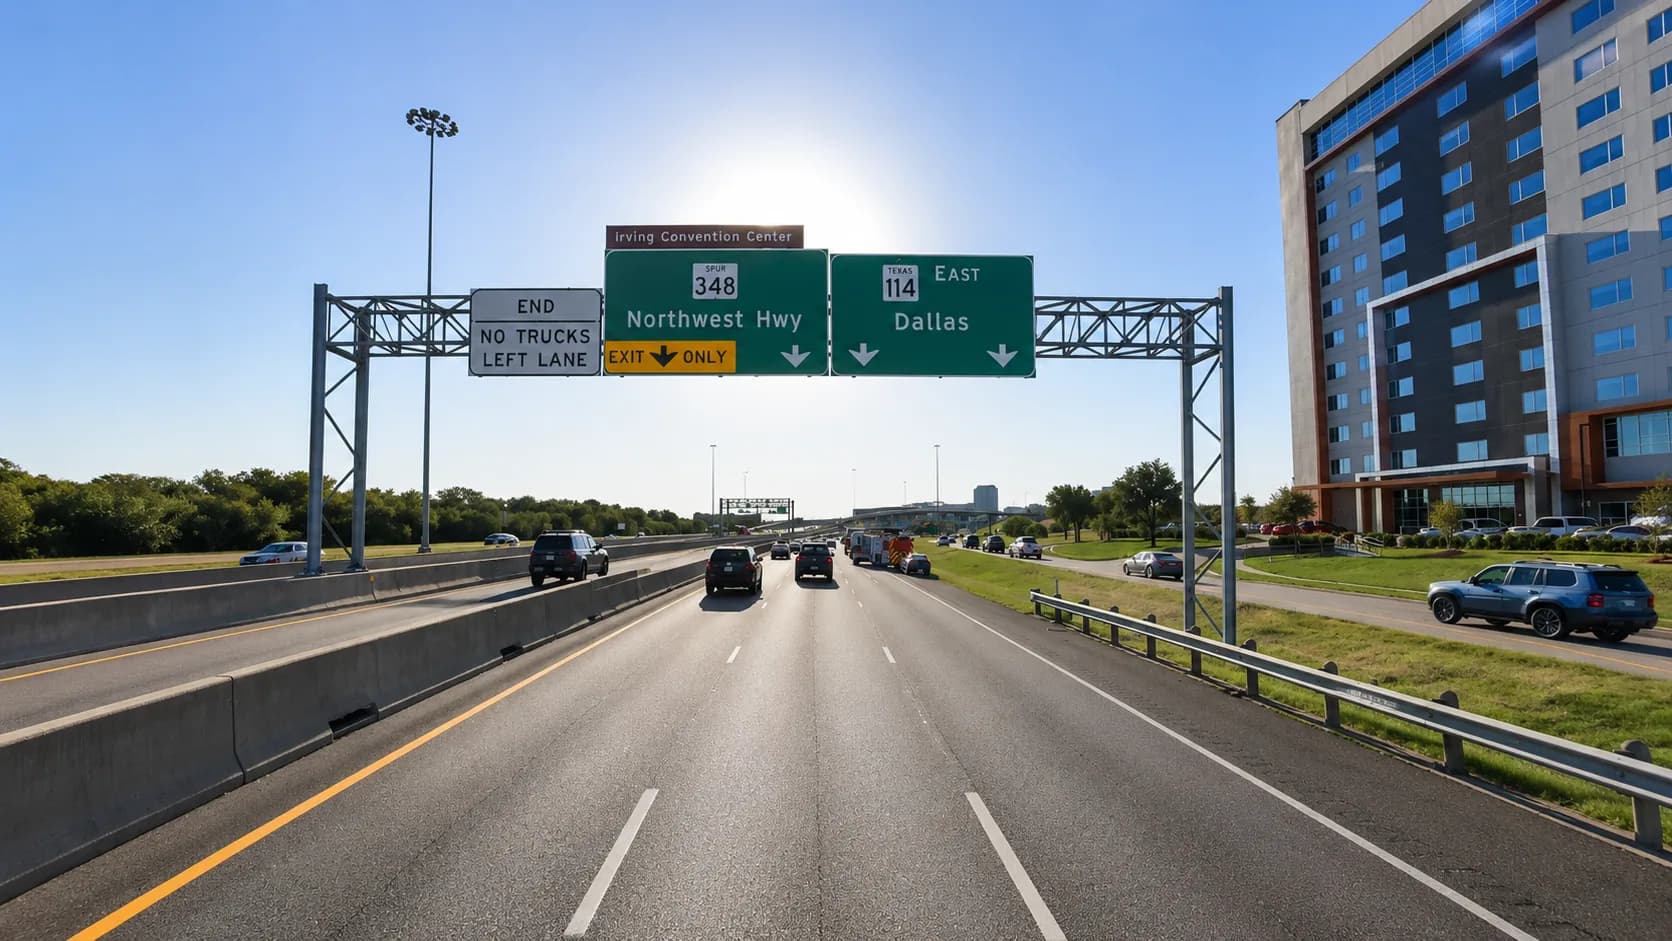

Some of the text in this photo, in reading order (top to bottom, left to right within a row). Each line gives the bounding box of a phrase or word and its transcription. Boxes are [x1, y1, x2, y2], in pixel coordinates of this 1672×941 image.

[615, 230, 793, 246] Irving Convention Center
[935, 265, 980, 282] EAST
[695, 276, 735, 295] 348
[886, 278, 916, 297] 114
[517, 298, 555, 314] END
[627, 309, 802, 333] Northwest Hwy
[895, 312, 969, 331] Dallas
[480, 328, 591, 344] NO TRUCKS
[483, 352, 588, 368] LEFT LANE
[608, 349, 728, 364] EXIT ONLY
